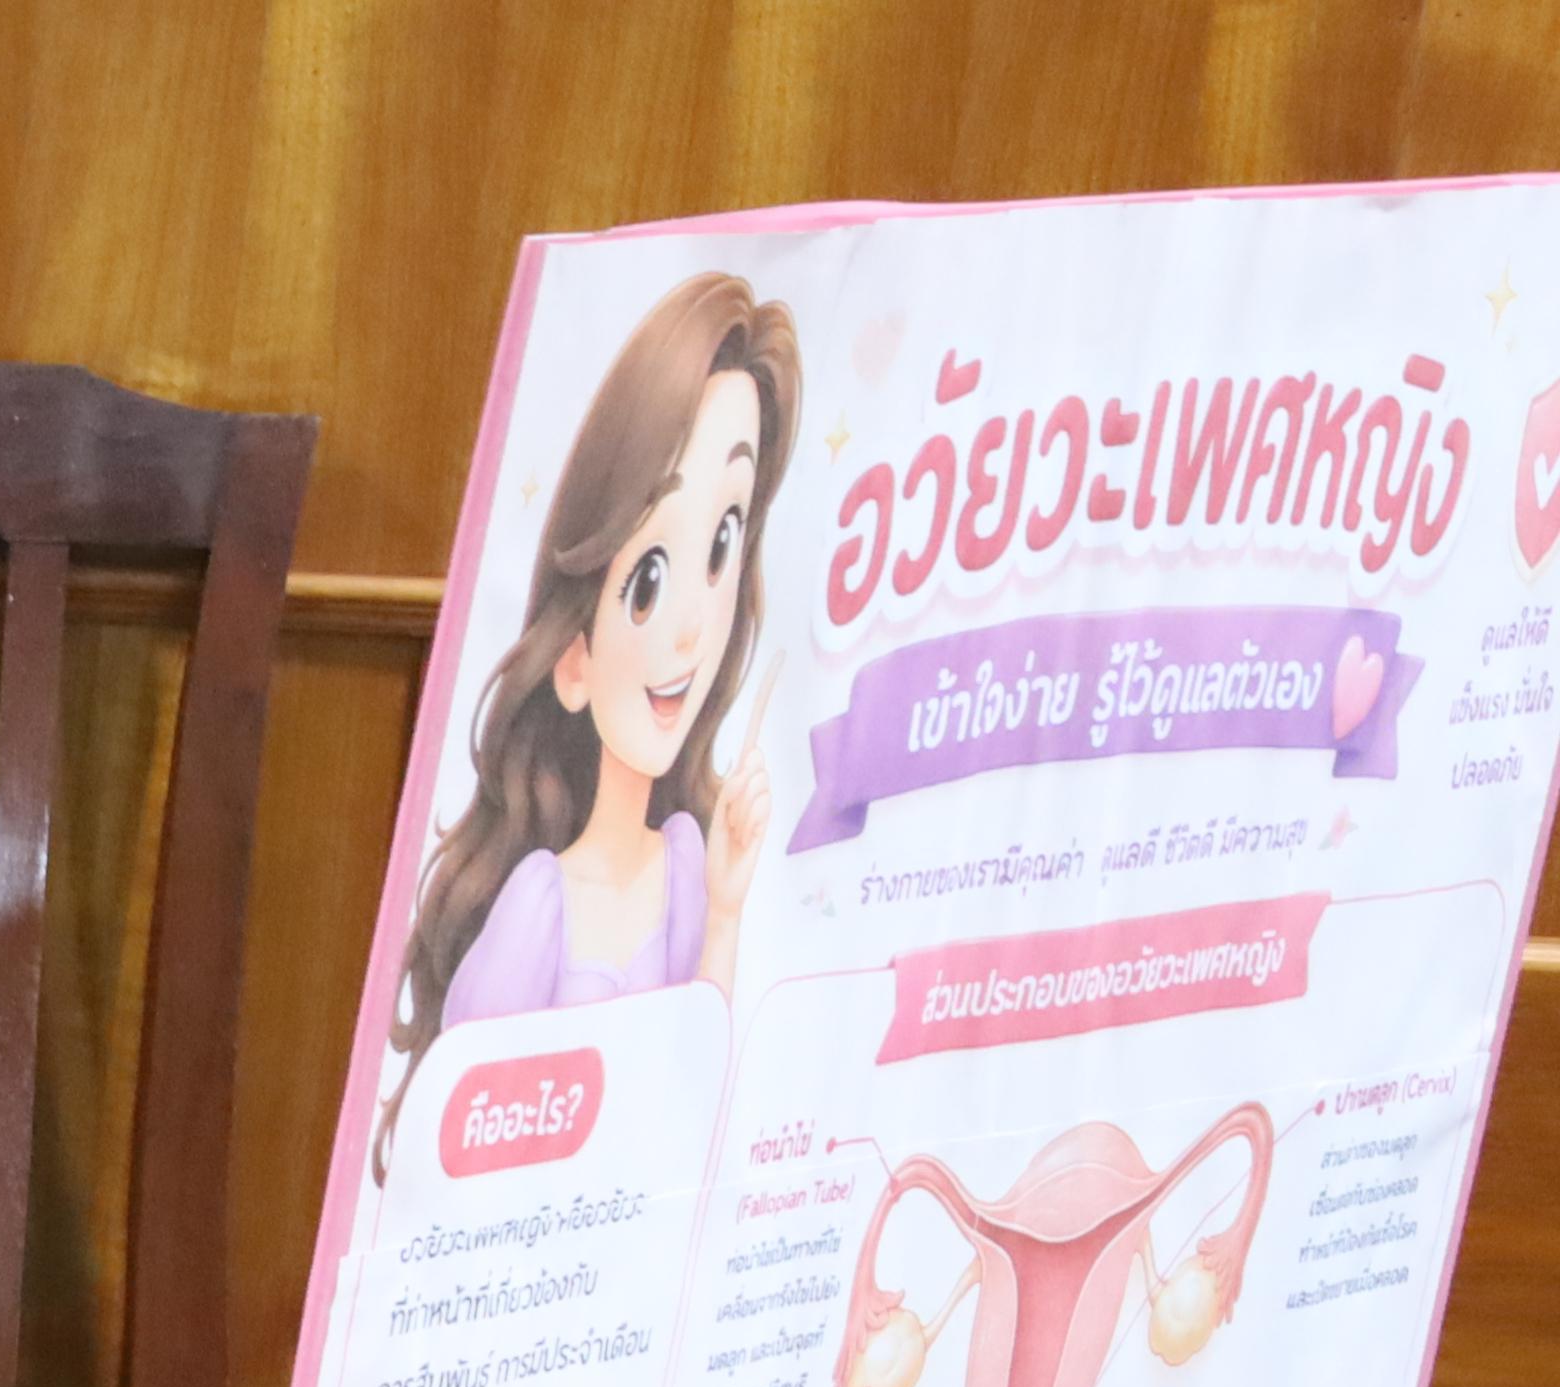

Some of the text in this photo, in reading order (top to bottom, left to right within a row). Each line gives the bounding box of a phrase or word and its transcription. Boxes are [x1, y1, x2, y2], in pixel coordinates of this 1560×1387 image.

[825, 347, 1472, 628] อวัยวะเพศหญิง
